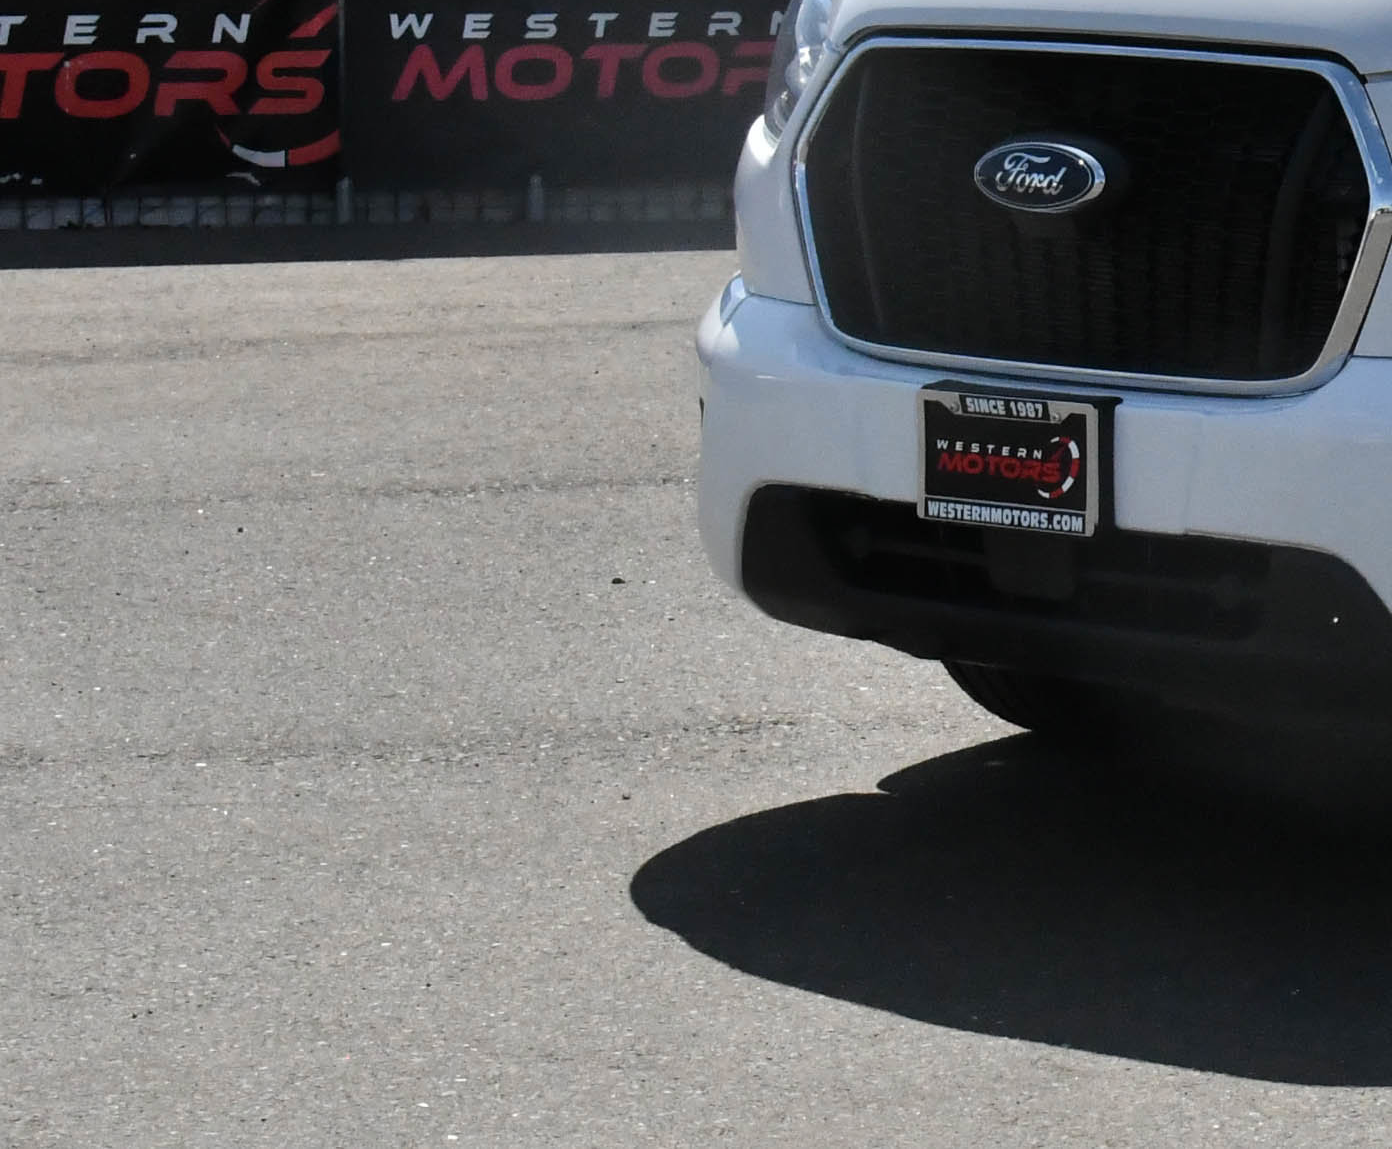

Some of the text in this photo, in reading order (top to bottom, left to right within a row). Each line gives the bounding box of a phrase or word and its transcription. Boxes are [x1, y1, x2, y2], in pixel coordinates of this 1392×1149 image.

[995, 152, 1068, 195] Ford
[965, 396, 1043, 419] SINCE 1987
[936, 439, 1043, 460] WESTERN
[938, 451, 1062, 484] MOTORS
[927, 501, 1083, 533] WESTERNMOTORS.COM
